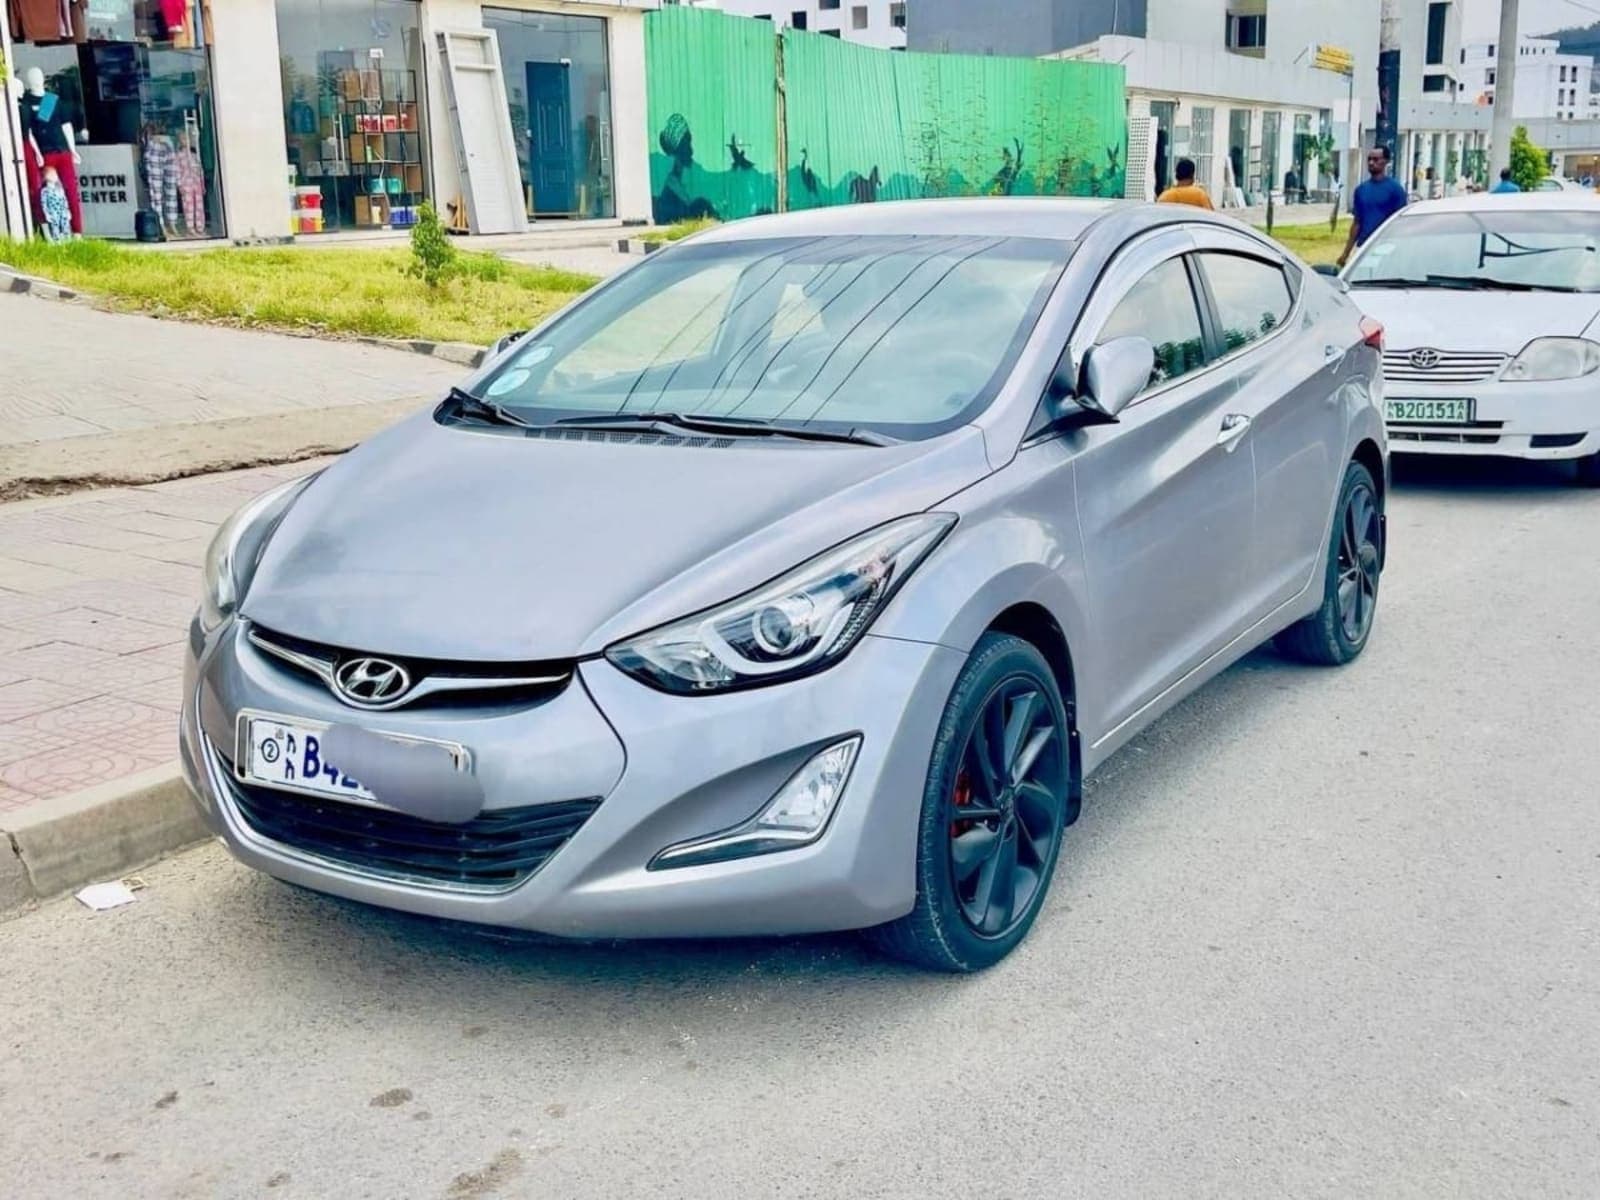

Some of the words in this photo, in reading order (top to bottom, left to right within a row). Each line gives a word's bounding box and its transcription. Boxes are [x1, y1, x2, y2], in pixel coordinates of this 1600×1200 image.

[75, 175, 126, 187] OTTON
[76, 191, 127, 203] ENTER
[1394, 402, 1455, 418] B20151
